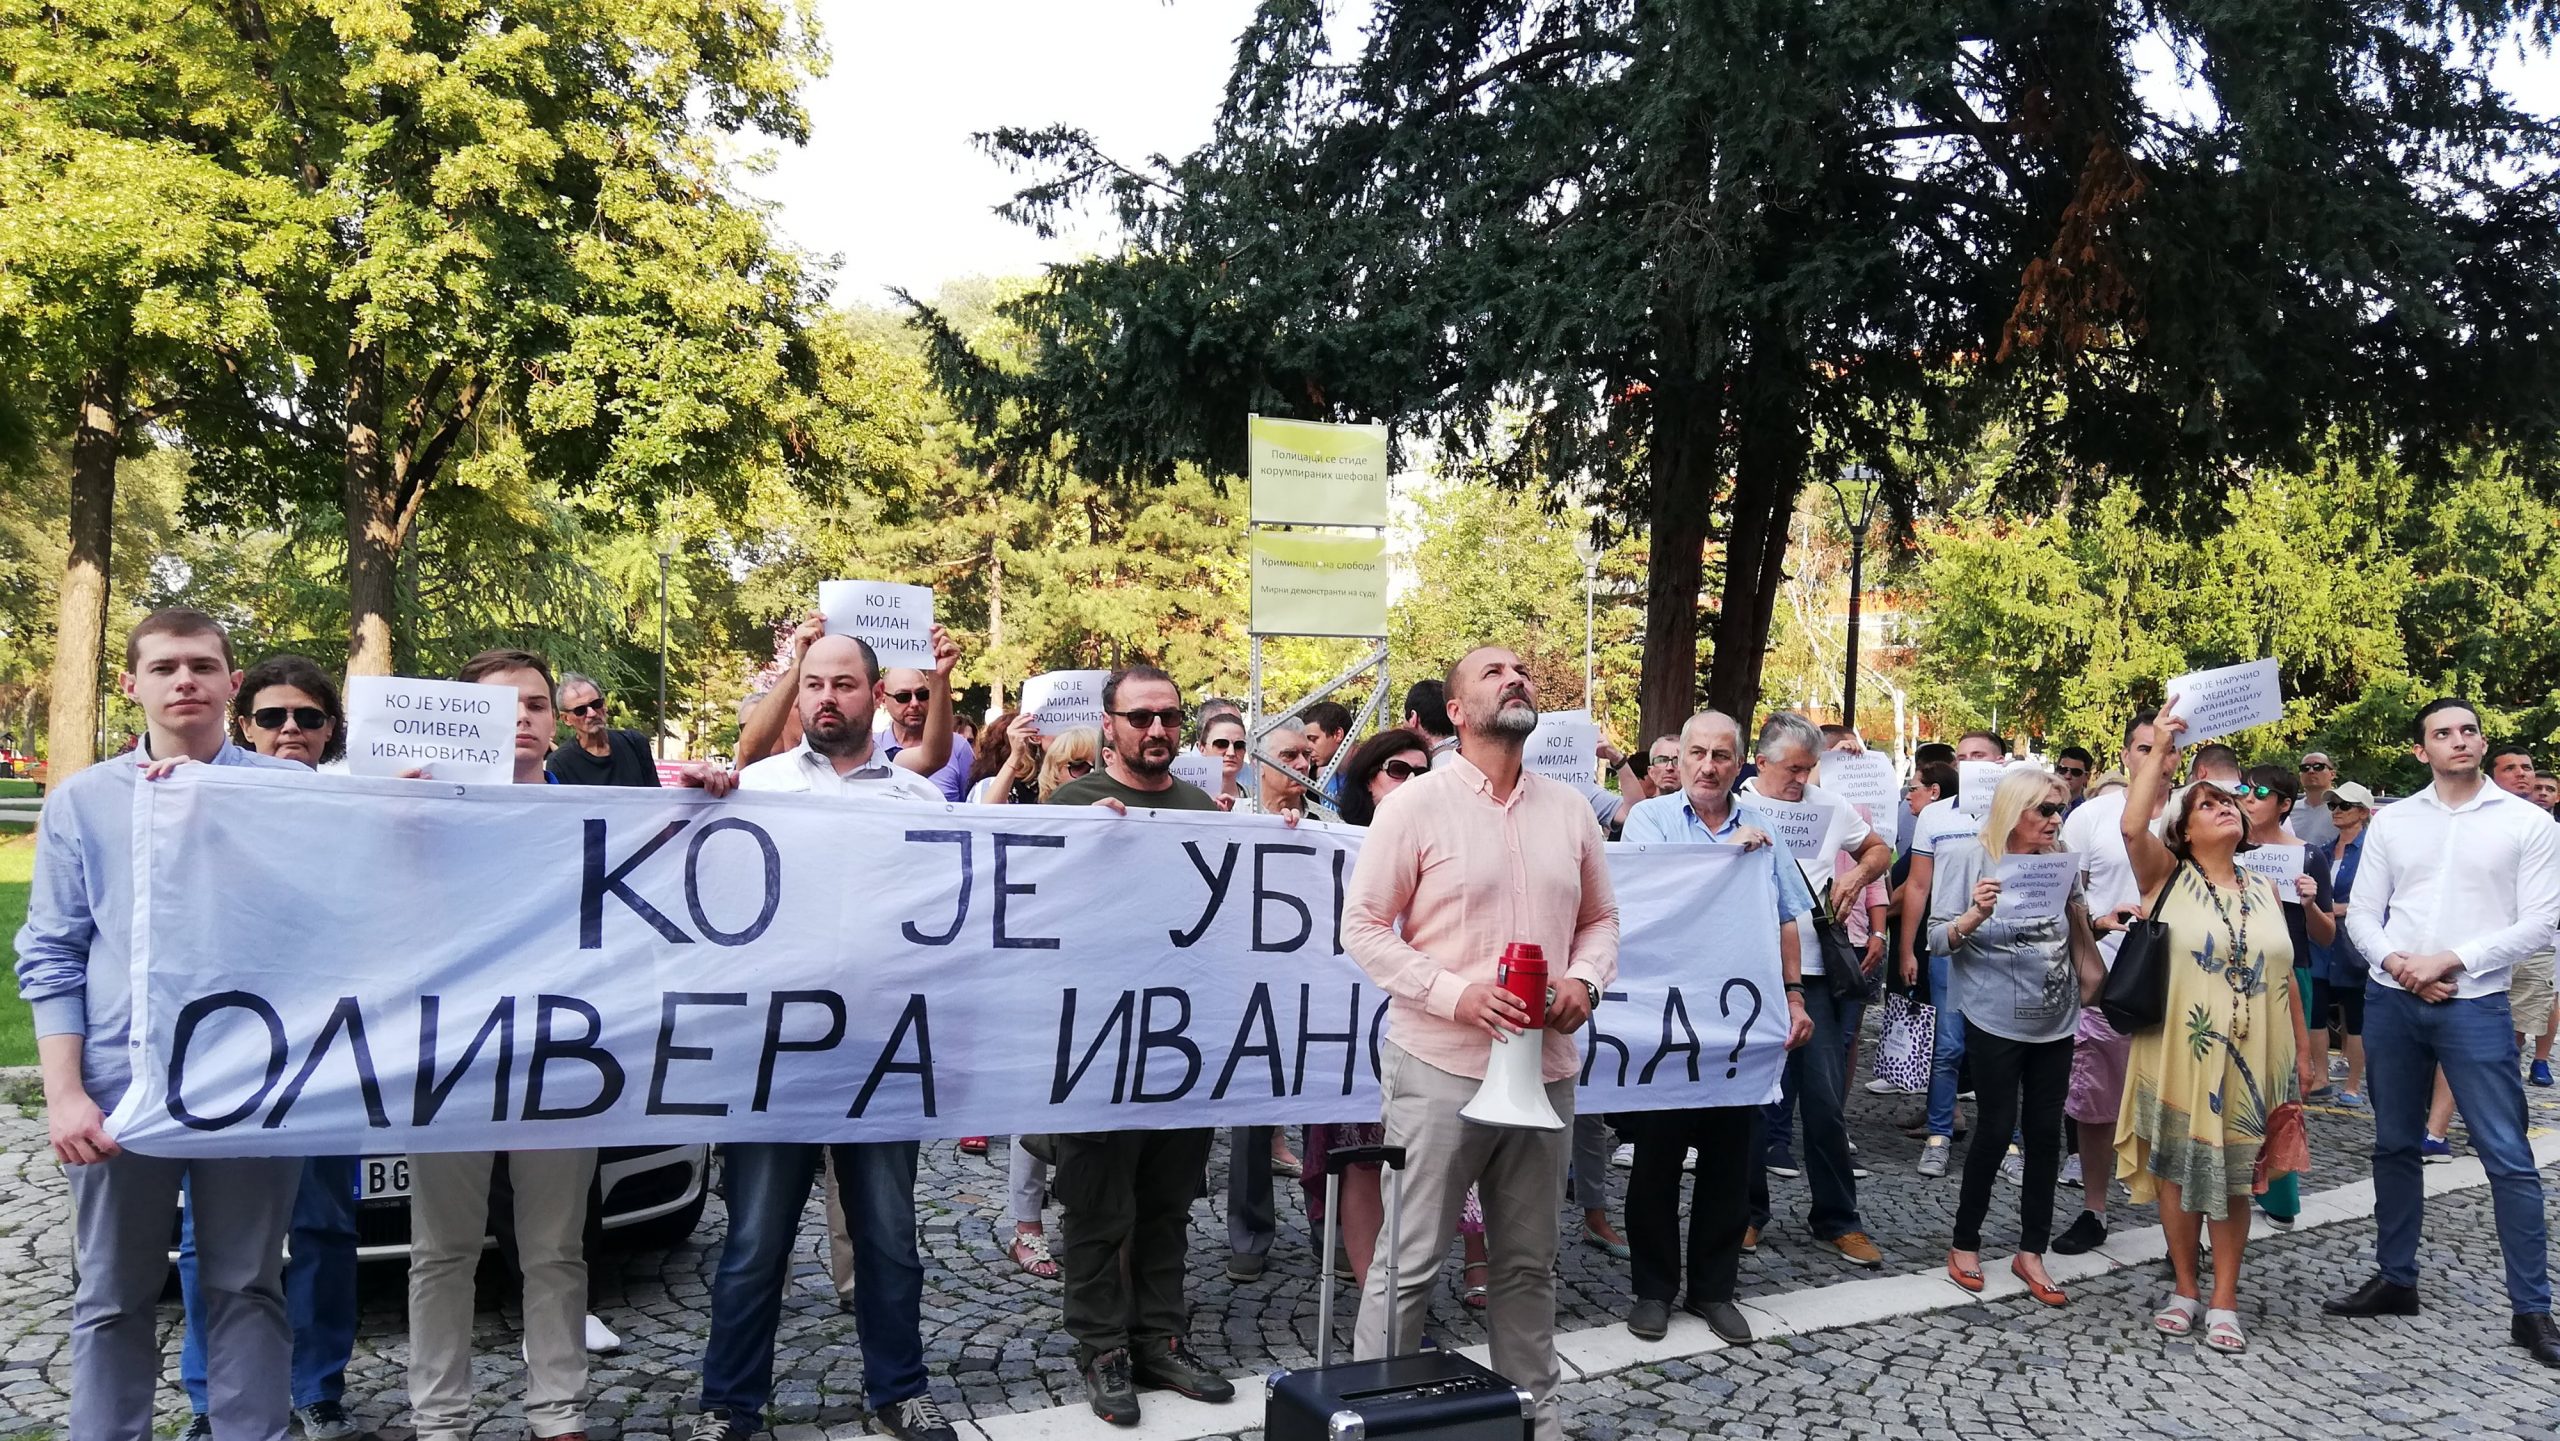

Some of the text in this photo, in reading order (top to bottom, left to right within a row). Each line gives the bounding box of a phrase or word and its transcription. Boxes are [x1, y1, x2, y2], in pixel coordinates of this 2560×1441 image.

[1271, 450, 1368, 467] Полицајци се стиде
[1260, 467, 1378, 483] корумпираних шефова!
[1260, 585, 1289, 596] Мирни
[1290, 588, 1347, 597] демонстранти
[865, 594, 902, 609] КО ЈЕ
[855, 614, 910, 630] МИЛАН
[1053, 680, 1083, 691] КО ЈЕ
[2189, 670, 2261, 693] КО ЈЕ НАРУЧИО
[2202, 683, 2251, 701] МЕДИЈСКУ
[385, 694, 492, 716] КО ЈЕ УБИО
[1046, 696, 1089, 707] МИЛАН
[2193, 690, 2263, 715] САТАНИЗАЦИЈУ
[2208, 704, 2250, 722] ОЛИВЕРА
[393, 719, 481, 739] ОЛИВЕРА
[2199, 711, 2261, 734] ИВАНОВИЋА?
[1547, 736, 1574, 748] КО ЈЕ
[371, 742, 501, 765] ИВАНОВИЋА?
[1537, 754, 1578, 766] МИЛАН
[1775, 809, 1788, 820] ЈЕ
[1788, 812, 1818, 822] УБИО
[2261, 853, 2290, 862] УБИО
[580, 815, 782, 950] КО
[901, 829, 1066, 950] ЈЕ
[165, 989, 938, 1131] ОЛИВЕРА
[369, 1160, 410, 1194] BG
